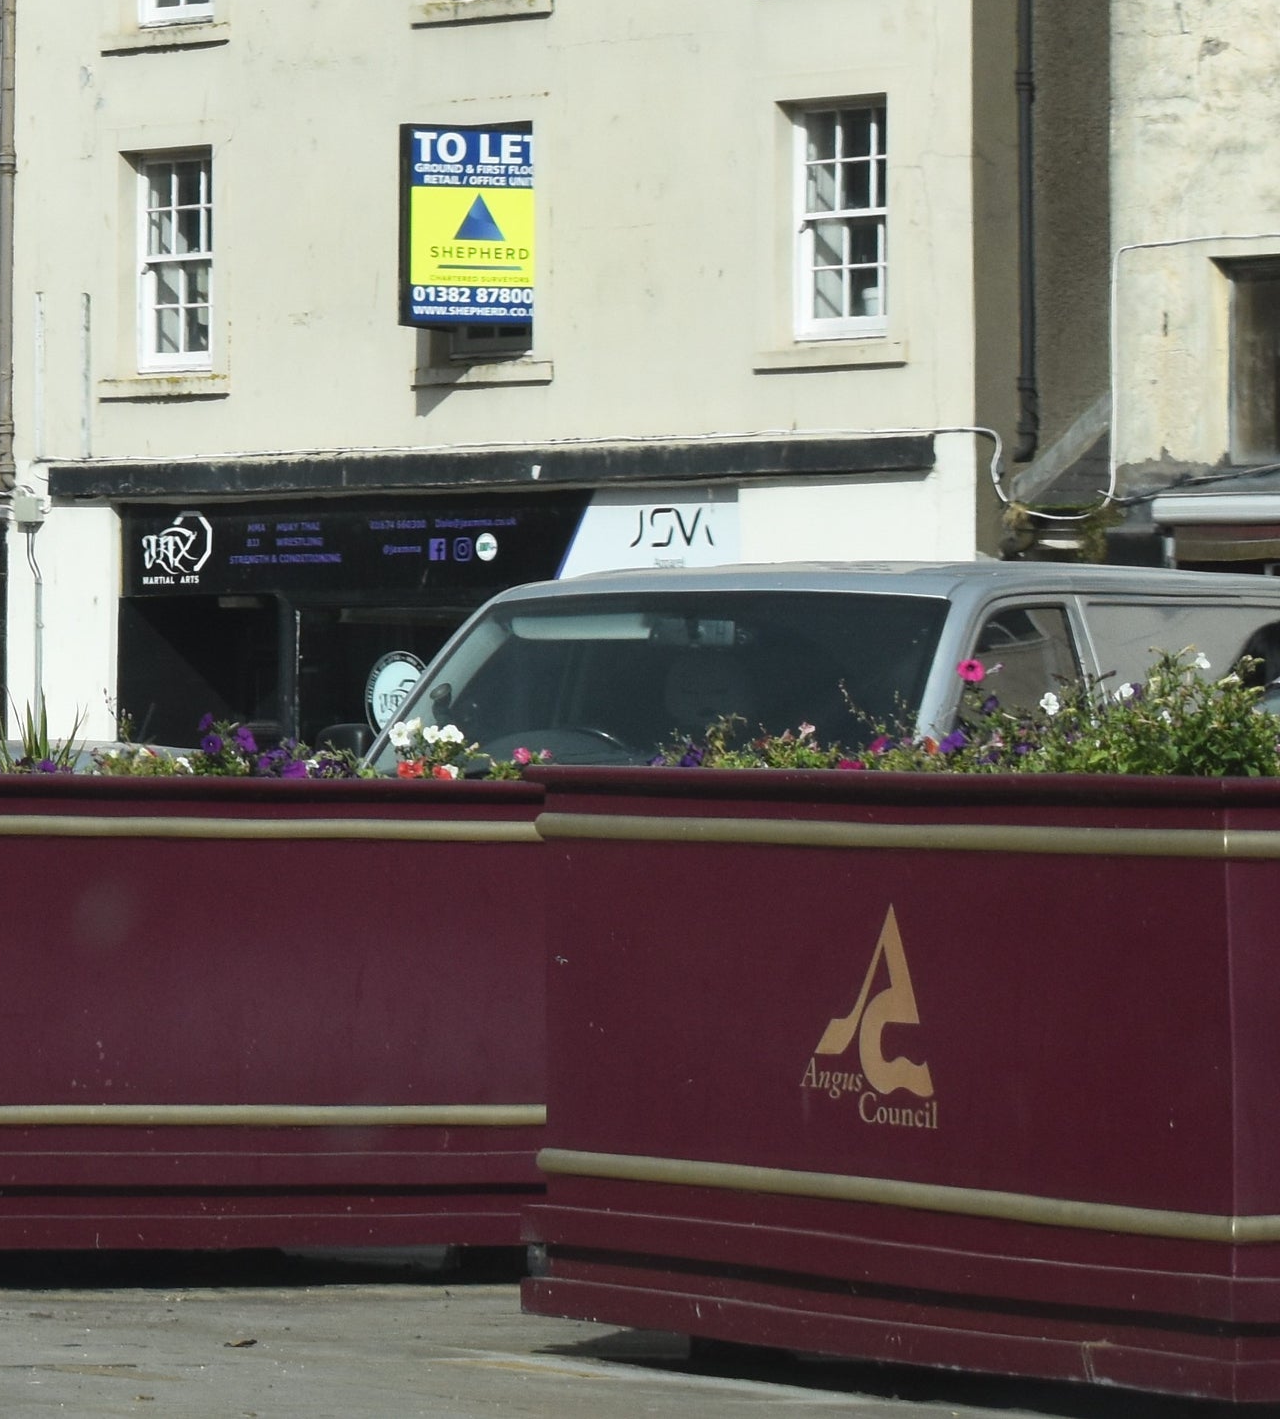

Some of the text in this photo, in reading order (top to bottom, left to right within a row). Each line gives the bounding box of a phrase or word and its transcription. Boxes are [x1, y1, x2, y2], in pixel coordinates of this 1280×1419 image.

[414, 132, 467, 163] TO
[414, 163, 464, 174] GROUND
[466, 164, 475, 174] &
[476, 165, 506, 174] FIRST
[424, 175, 461, 185] RETAIL
[469, 176, 506, 186] OFFICE
[430, 246, 529, 260] SHEPHERD
[430, 274, 479, 283] CHARTERED
[413, 286, 471, 302] 01382
[142, 575, 199, 585] MARTIAL ARTS
[799, 1057, 864, 1099] Angus
[858, 1091, 939, 1130] Council
